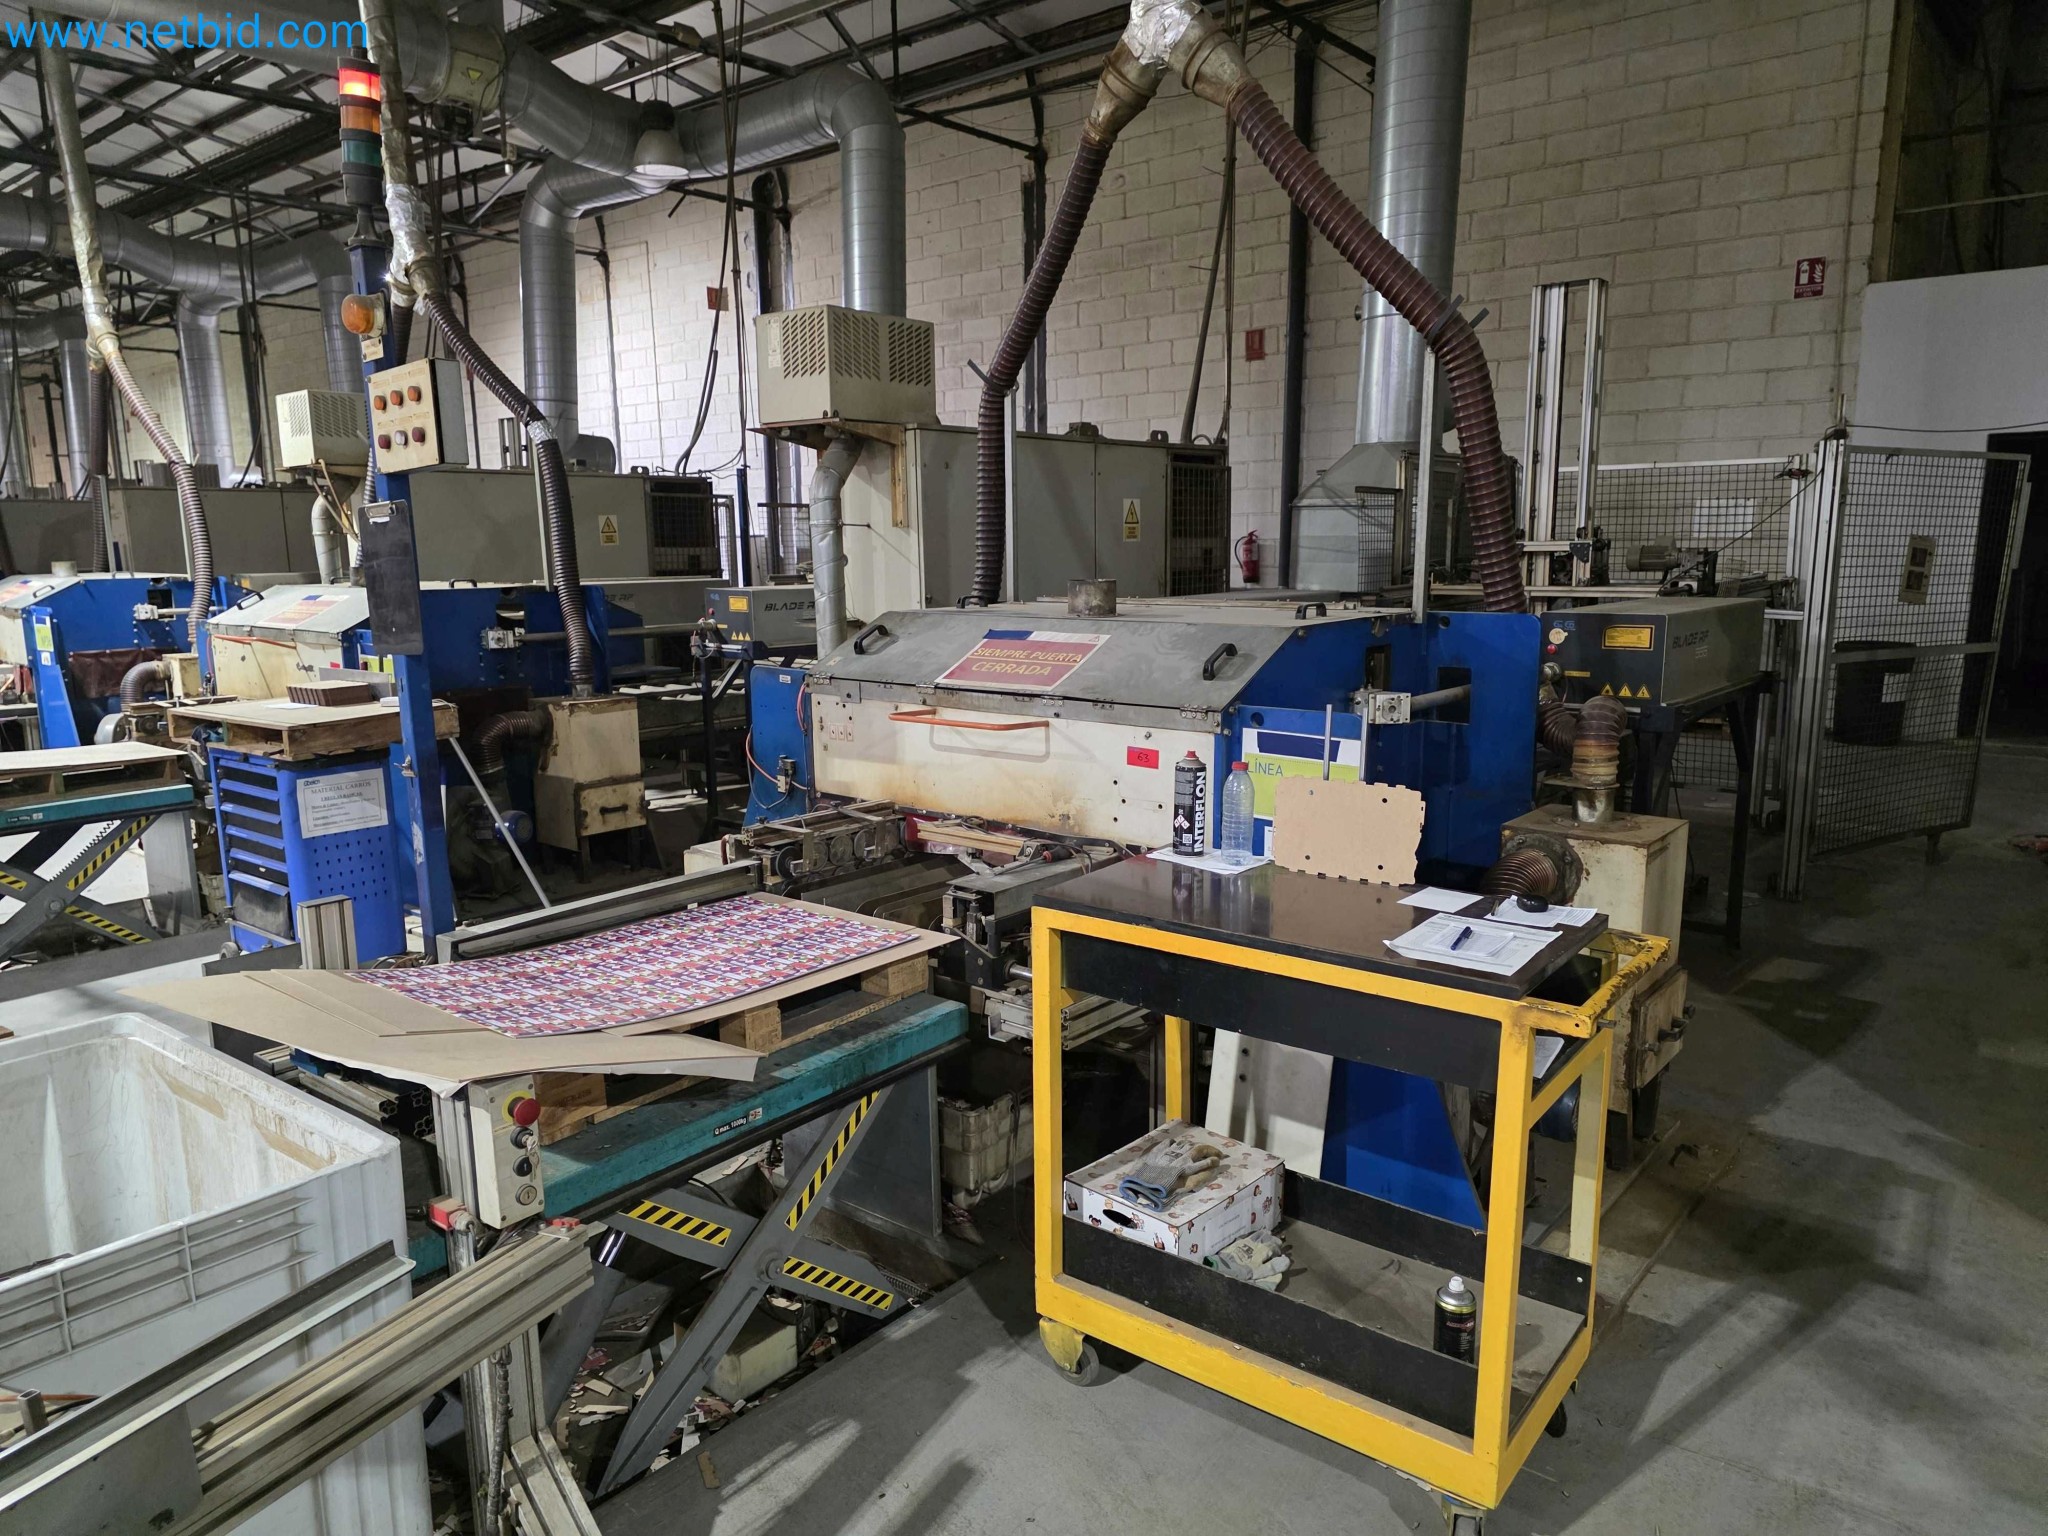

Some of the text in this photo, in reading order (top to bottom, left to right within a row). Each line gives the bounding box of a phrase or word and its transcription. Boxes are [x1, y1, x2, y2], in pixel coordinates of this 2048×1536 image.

[764, 601, 805, 612] BLADE
[974, 647, 1083, 662] SIEMPRE PUERTA
[971, 662, 1053, 676] CERRADA
[1137, 751, 1150, 763] 63
[1248, 758, 1284, 777] LÍNEA
[1193, 771, 1206, 853] INTERFLON
